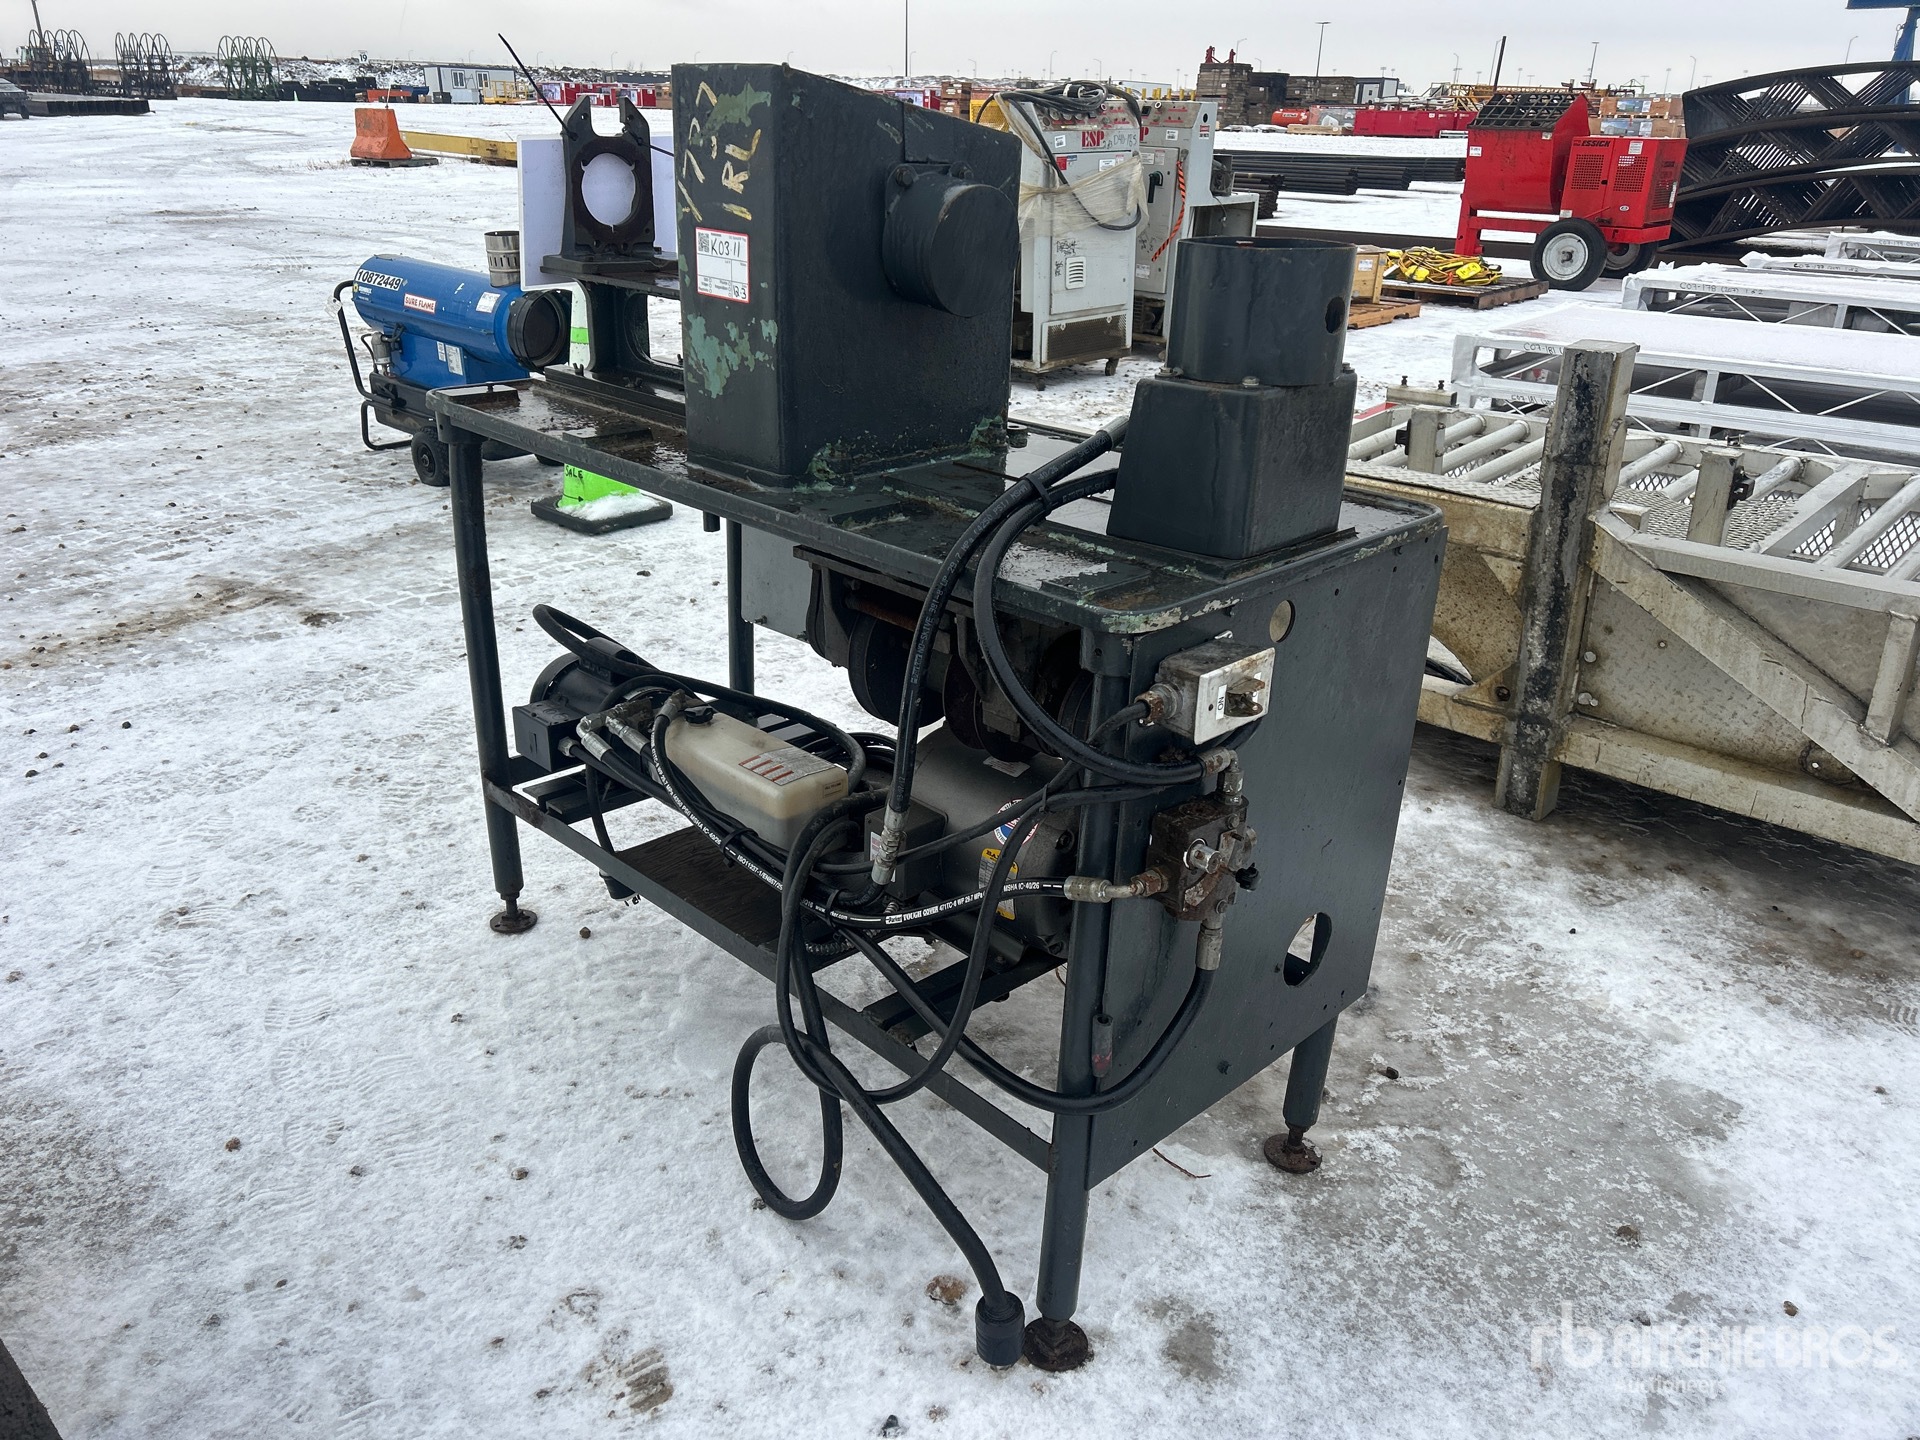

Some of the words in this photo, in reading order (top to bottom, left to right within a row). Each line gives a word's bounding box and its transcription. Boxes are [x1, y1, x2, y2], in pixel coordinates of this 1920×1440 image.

[359, 54, 368, 62] 19
[1081, 130, 1105, 147] ESP
[356, 269, 402, 290] 10872449
[405, 296, 418, 307] SURE
[418, 300, 435, 311] FLAME
[565, 464, 584, 479] SALE
[688, 814, 704, 829] MSHA
[1003, 883, 1018, 892] MSHA
[1018, 882, 1040, 890] IC-40/26
[903, 910, 922, 921] TOUGH
[922, 906, 939, 917] COVER
